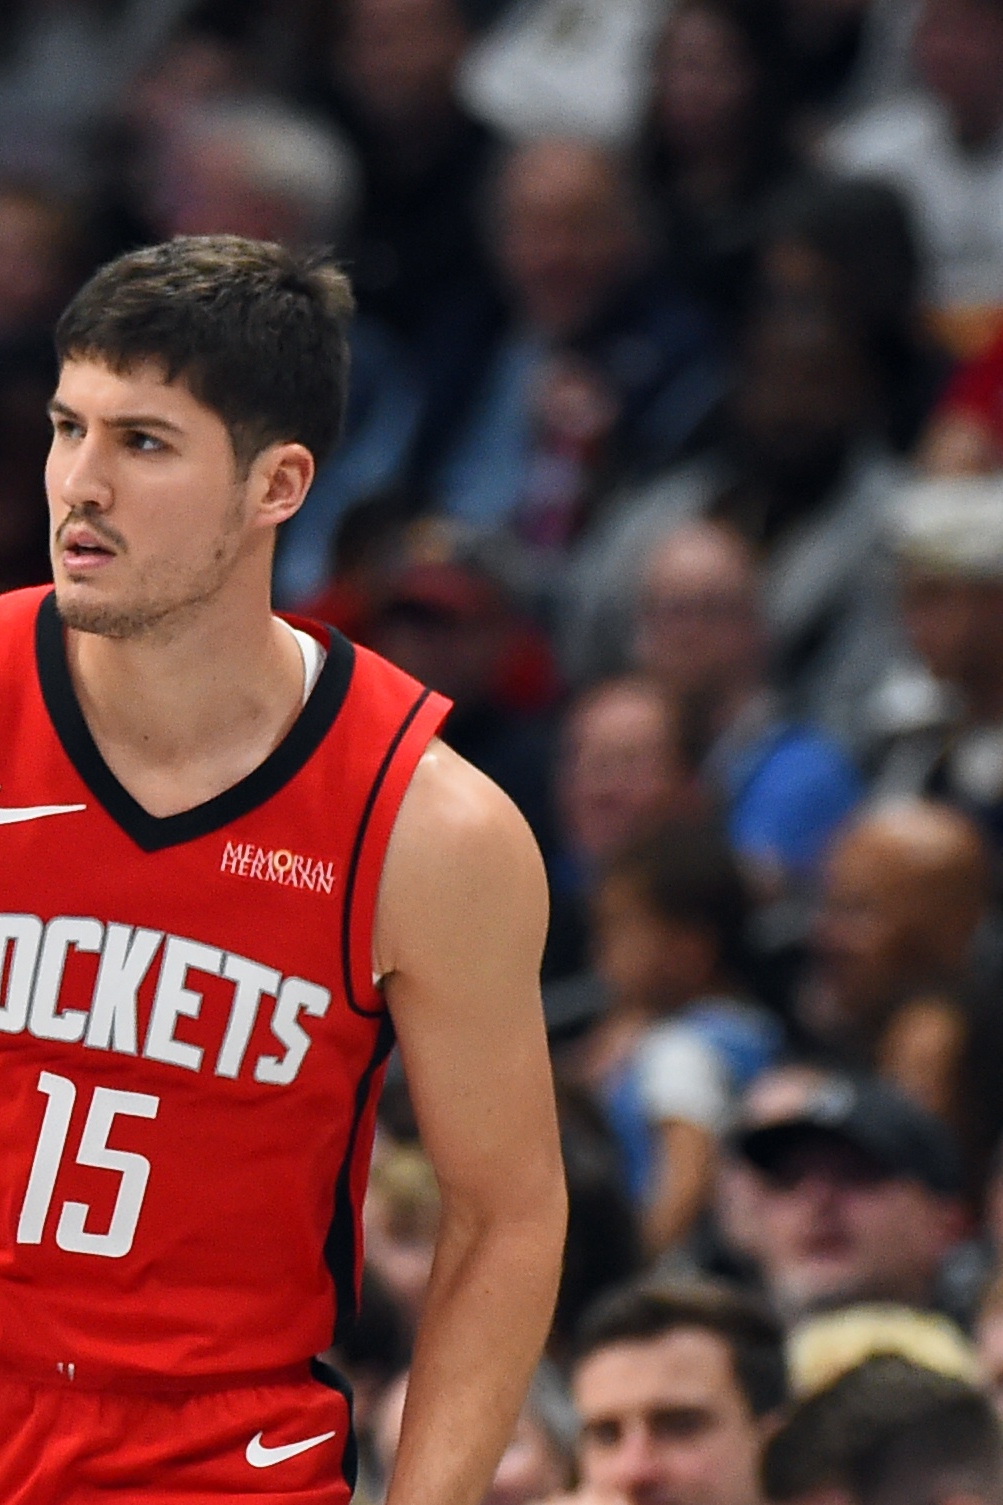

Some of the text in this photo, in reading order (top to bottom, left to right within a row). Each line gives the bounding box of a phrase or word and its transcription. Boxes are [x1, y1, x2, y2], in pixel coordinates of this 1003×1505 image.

[220, 856, 335, 894] HERMANN
[222, 841, 334, 880] MEMORIAL
[16, 1070, 160, 1258] 15
